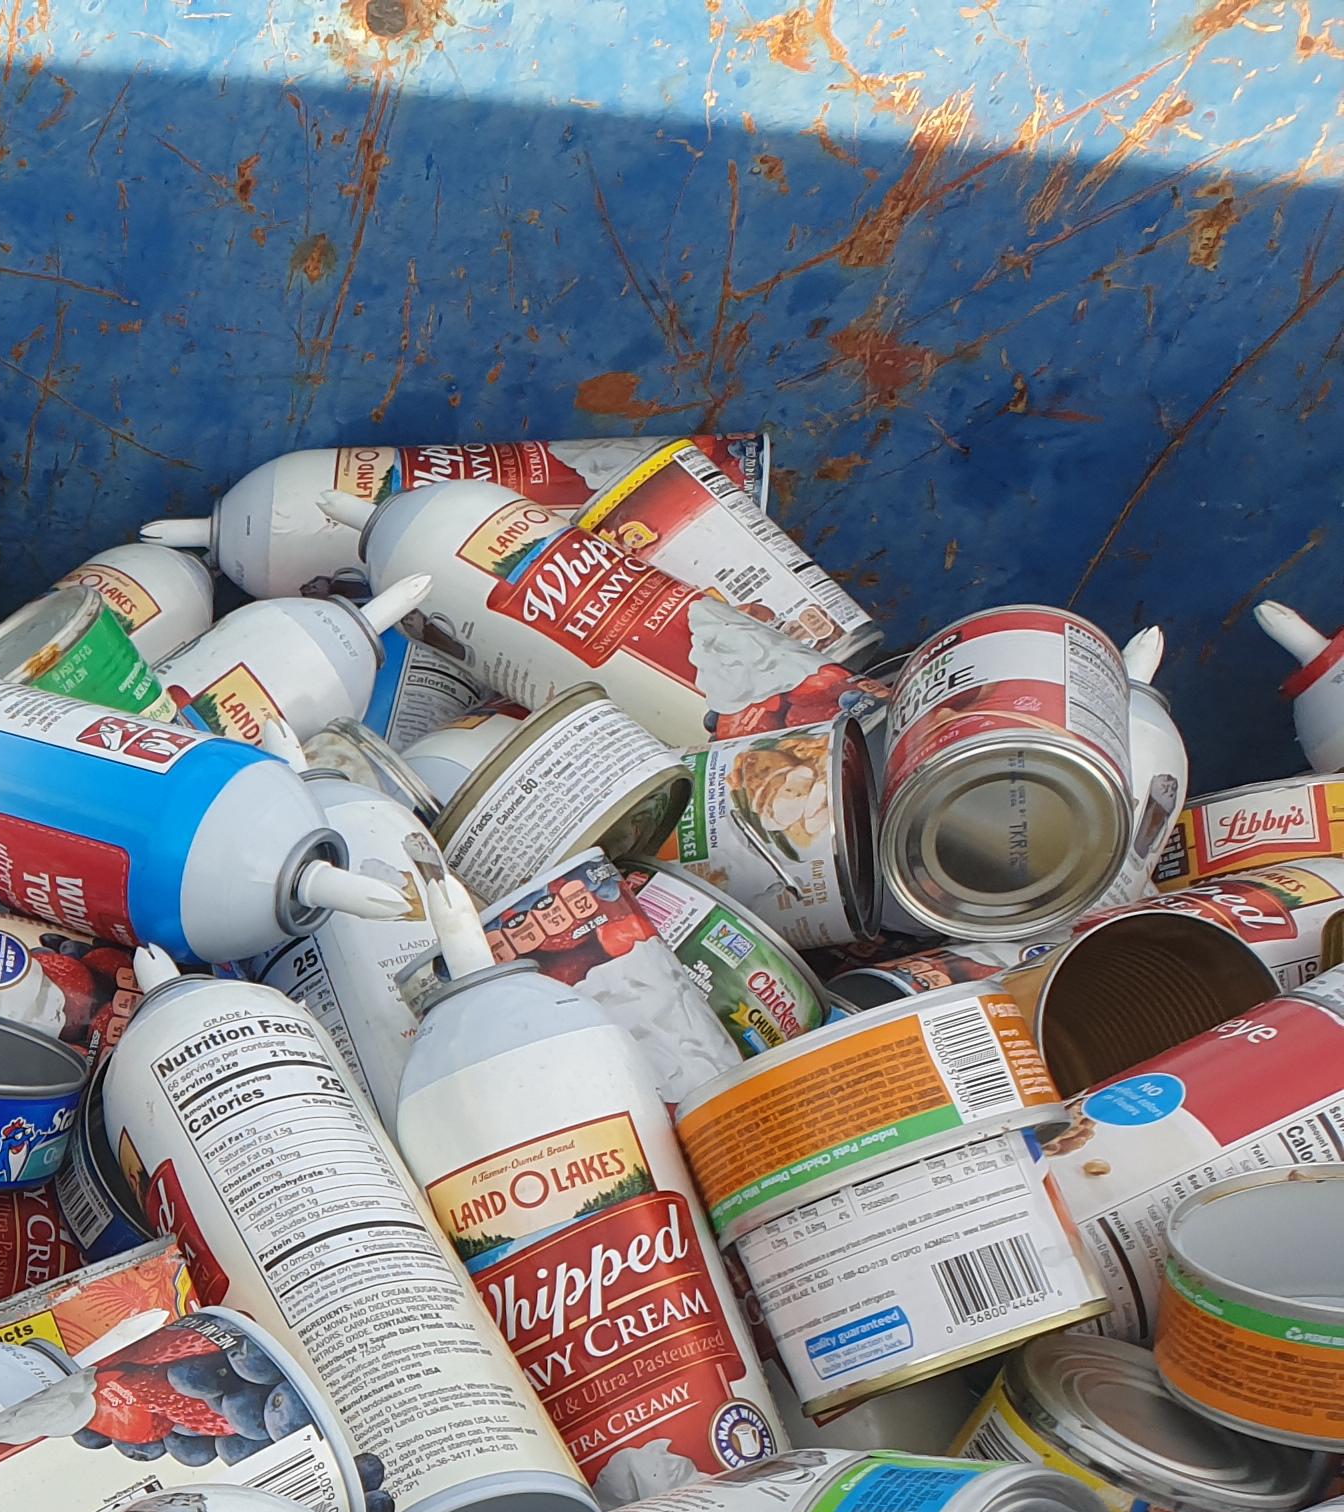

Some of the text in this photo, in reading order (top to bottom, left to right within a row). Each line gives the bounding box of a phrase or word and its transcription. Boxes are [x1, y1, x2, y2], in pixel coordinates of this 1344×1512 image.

[488, 520, 529, 556] LAND
[564, 567, 634, 640] HEAVY
[593, 598, 644, 653] Sweetened
[521, 779, 538, 795] 80
[1214, 805, 1305, 848] Libby's
[203, 1012, 241, 1027] GRADE
[157, 1020, 314, 1077] Nutrition Facts
[168, 1039, 286, 1092] 66 servings container
[172, 1060, 238, 1101] Serving size
[183, 1072, 271, 1119] Amount serving
[188, 1075, 345, 1134] Calories 25
[204, 1142, 226, 1160] Total
[478, 1141, 575, 1183] Farmer-Owned Brand
[222, 1160, 274, 1193] Cholesterol
[449, 1191, 506, 1233] LAND
[552, 1148, 626, 1192] LAKES
[584, 1289, 710, 1358] CREAM
[838, 1312, 900, 1343] guaranteed
[966, 1292, 1046, 1326] 36800 44649
[581, 1330, 724, 1405] Ultra-Pasteurized
[607, 1382, 691, 1434] CREAMY
